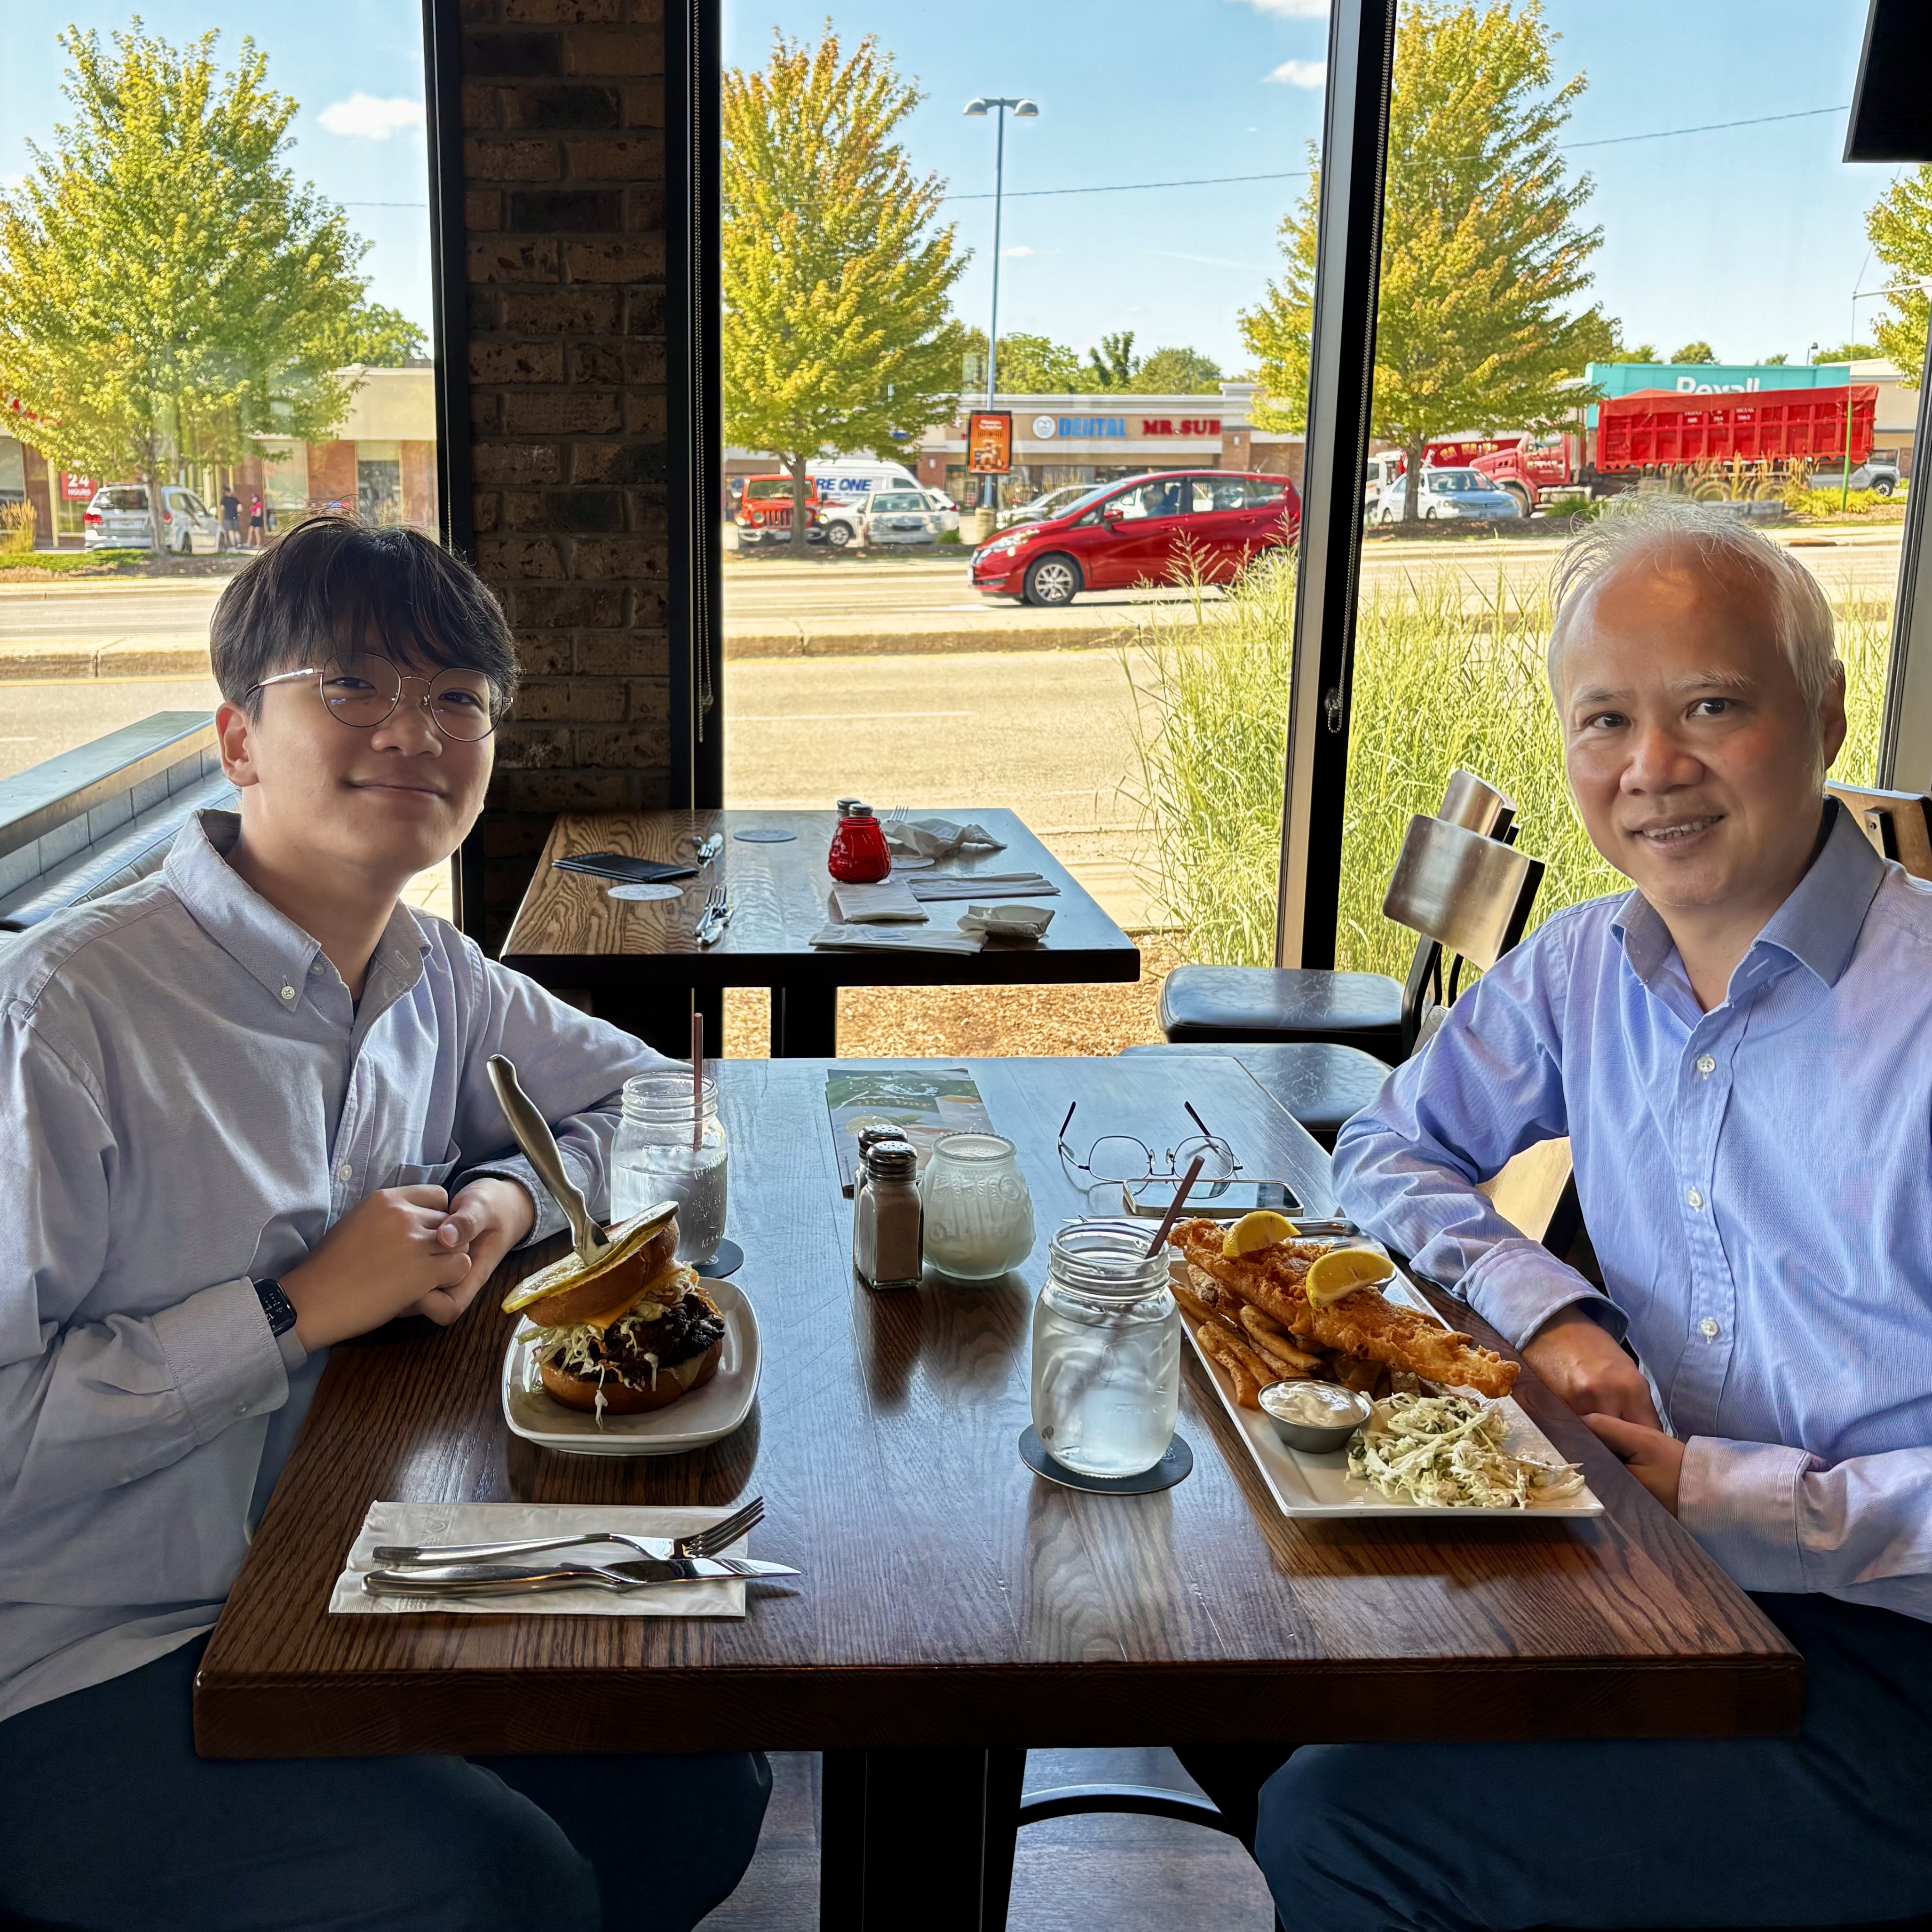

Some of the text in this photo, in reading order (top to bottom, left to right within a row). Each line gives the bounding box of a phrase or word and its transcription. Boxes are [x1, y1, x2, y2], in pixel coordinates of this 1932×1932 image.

[1058, 417, 1127, 437] DENTAL
[68, 473, 90, 488] 24
[839, 479, 872, 491] ONE
